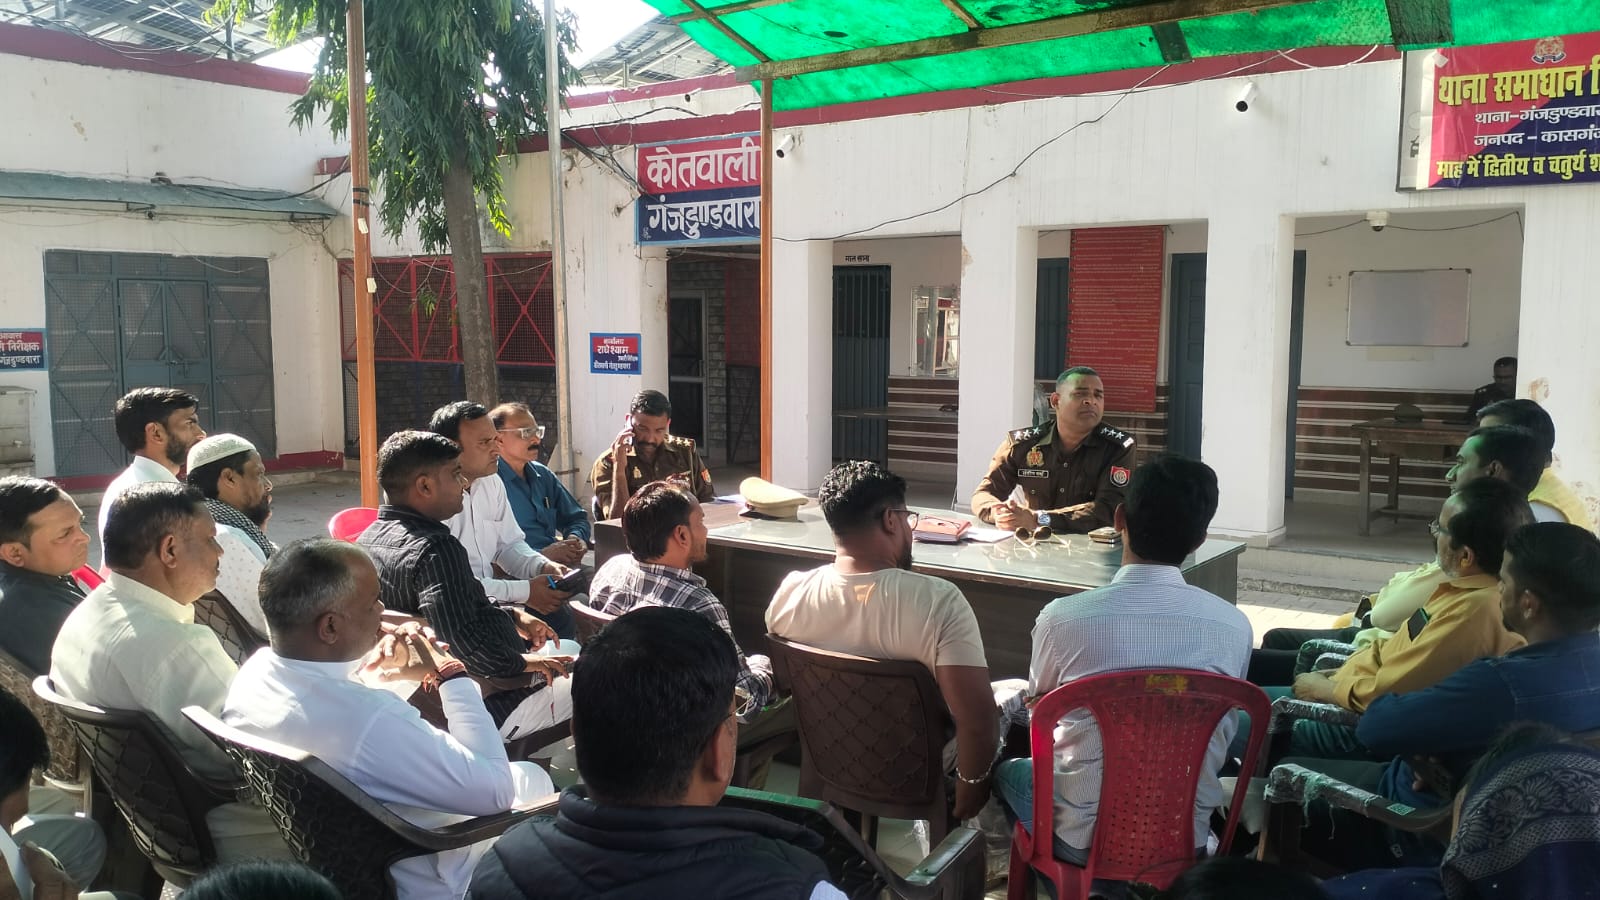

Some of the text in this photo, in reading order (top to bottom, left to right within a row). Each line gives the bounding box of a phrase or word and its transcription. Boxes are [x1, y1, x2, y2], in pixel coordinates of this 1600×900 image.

[1438, 74, 1489, 105] थाना
[1493, 66, 1586, 102] समाधान
[1474, 132, 1525, 147] जनपद
[645, 136, 761, 189] कोतवाली
[1436, 161, 1463, 179] माह
[1466, 155, 1481, 177] में
[1483, 153, 1530, 177] द्वितीय
[1533, 157, 1545, 175] व
[1548, 149, 1586, 180] चतुर्थ
[646, 195, 761, 239] गंजडुण्डवारा
[7, 339, 40, 352] निरीक्षक
